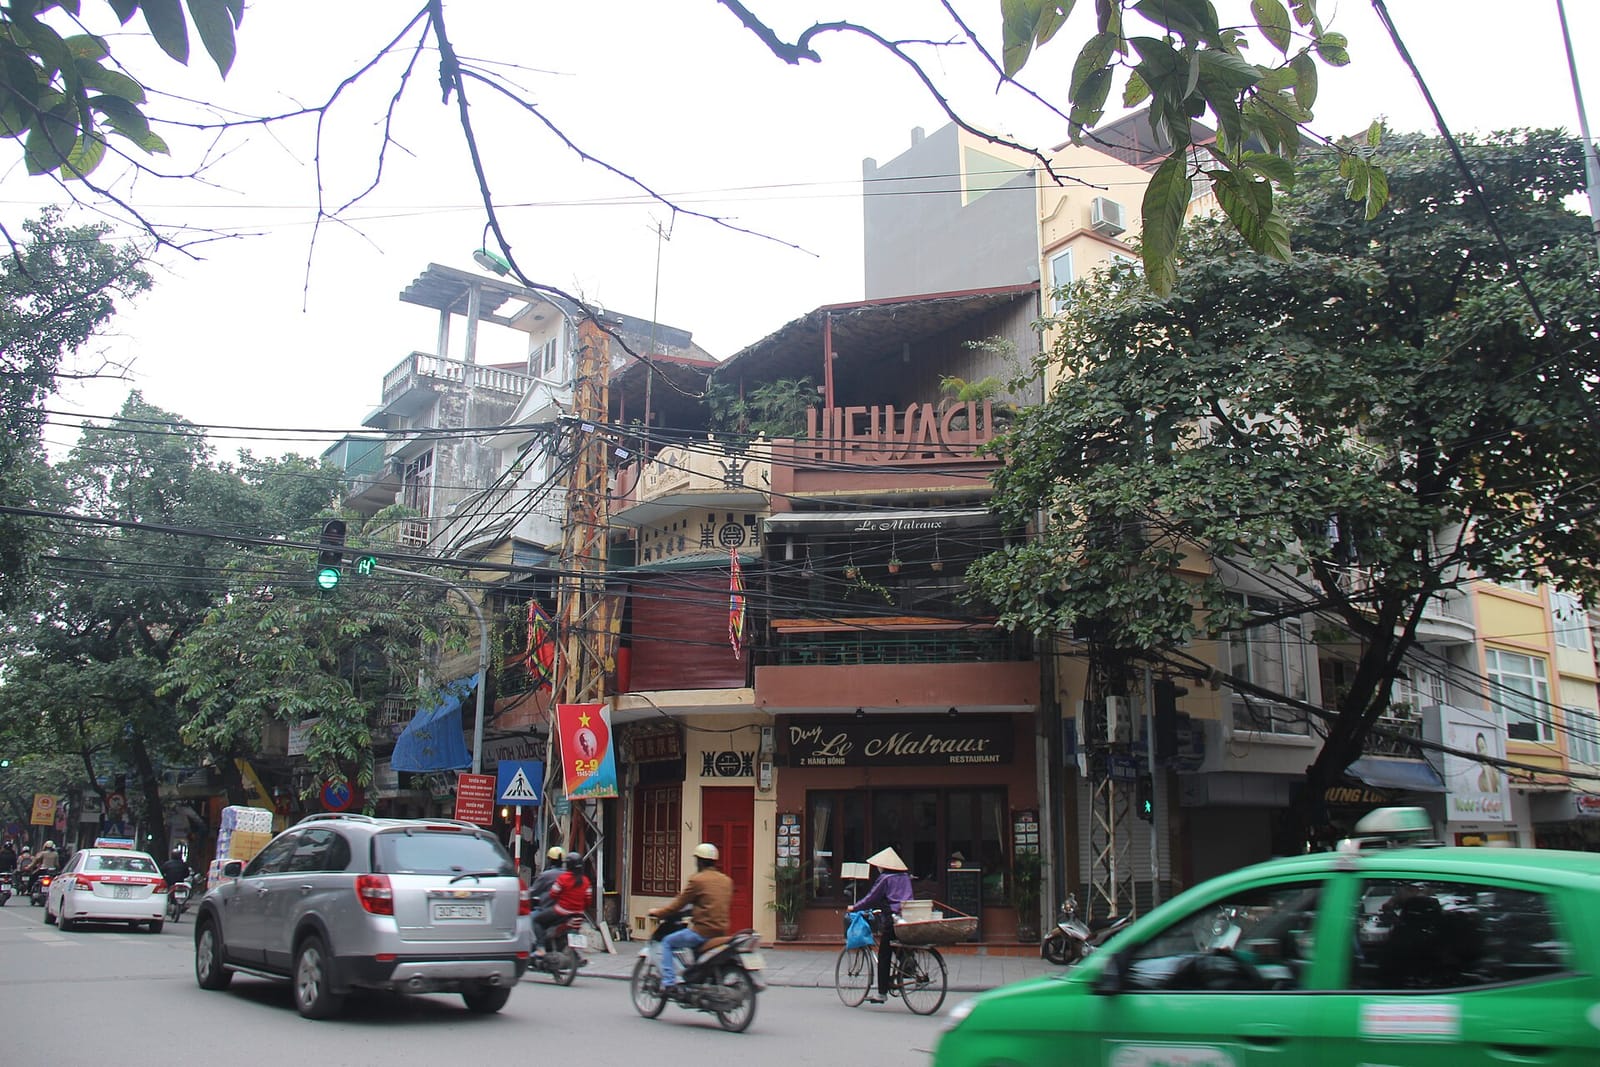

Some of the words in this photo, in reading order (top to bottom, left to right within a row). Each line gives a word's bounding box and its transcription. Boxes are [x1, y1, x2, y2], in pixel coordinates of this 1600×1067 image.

[854, 519, 877, 532] Le
[879, 519, 942, 532] Malraux
[789, 725, 823, 745] Duy
[812, 732, 855, 757] Le
[864, 731, 990, 757] Malraux
[949, 754, 1001, 763] RESTAURANT
[575, 759, 599, 772] 2-9
